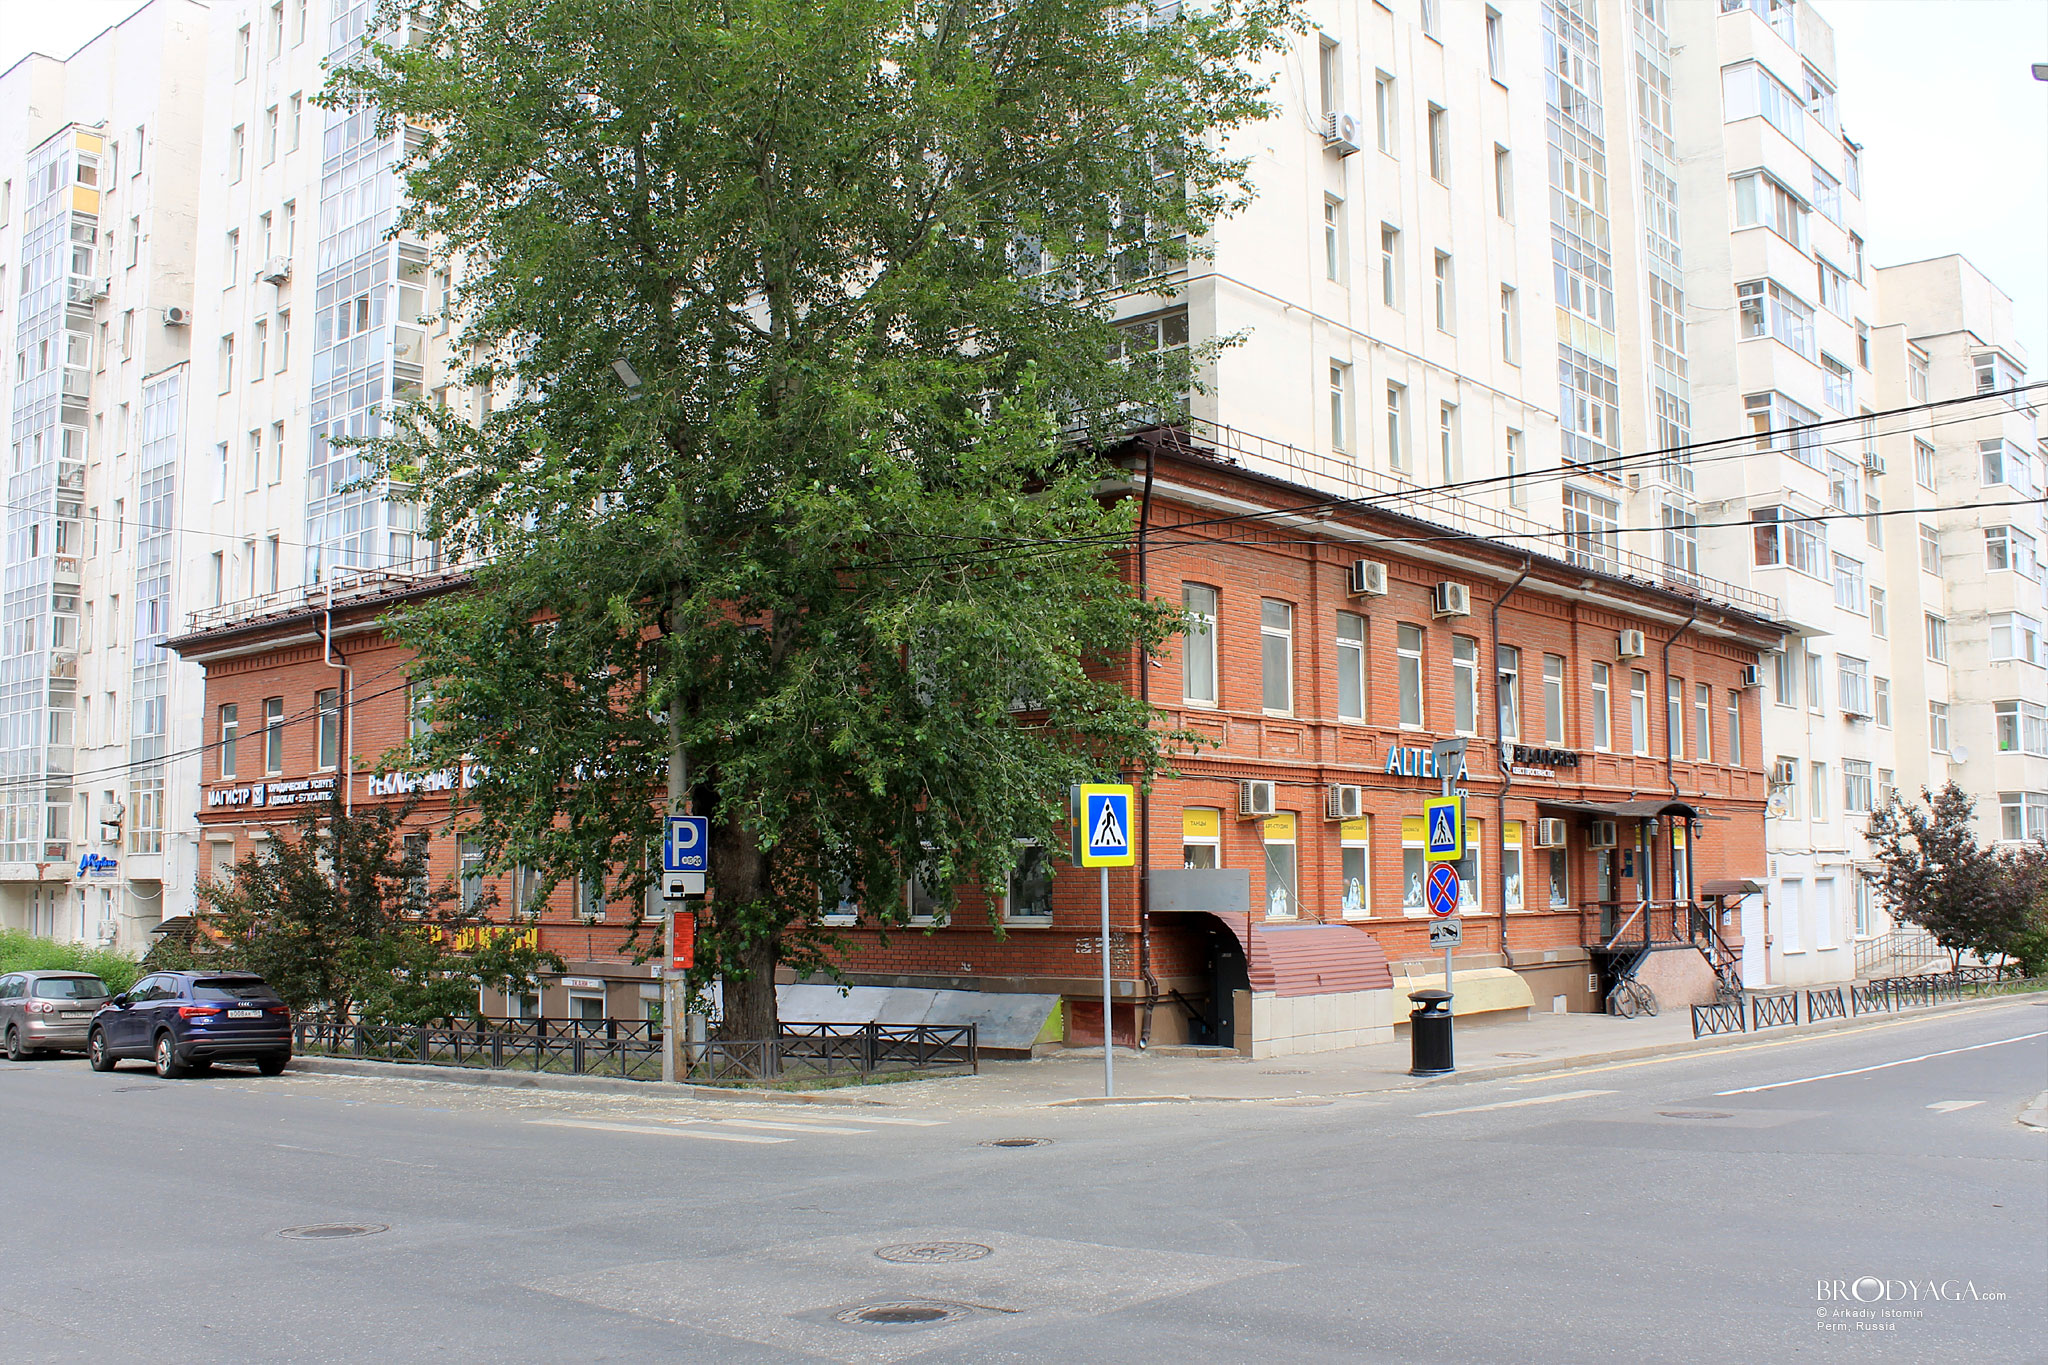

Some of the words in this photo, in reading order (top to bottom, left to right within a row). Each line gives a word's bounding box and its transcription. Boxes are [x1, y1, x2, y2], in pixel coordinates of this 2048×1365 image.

[1385, 745, 1470, 781] ALTEA
[267, 780, 310, 793] ЮРИДИЧЕСКИЕ
[368, 766, 459, 796] РЕКЛАНАЯ
[207, 788, 250, 806] МАГИСТР
[267, 793, 296, 806] АДВОКАТ
